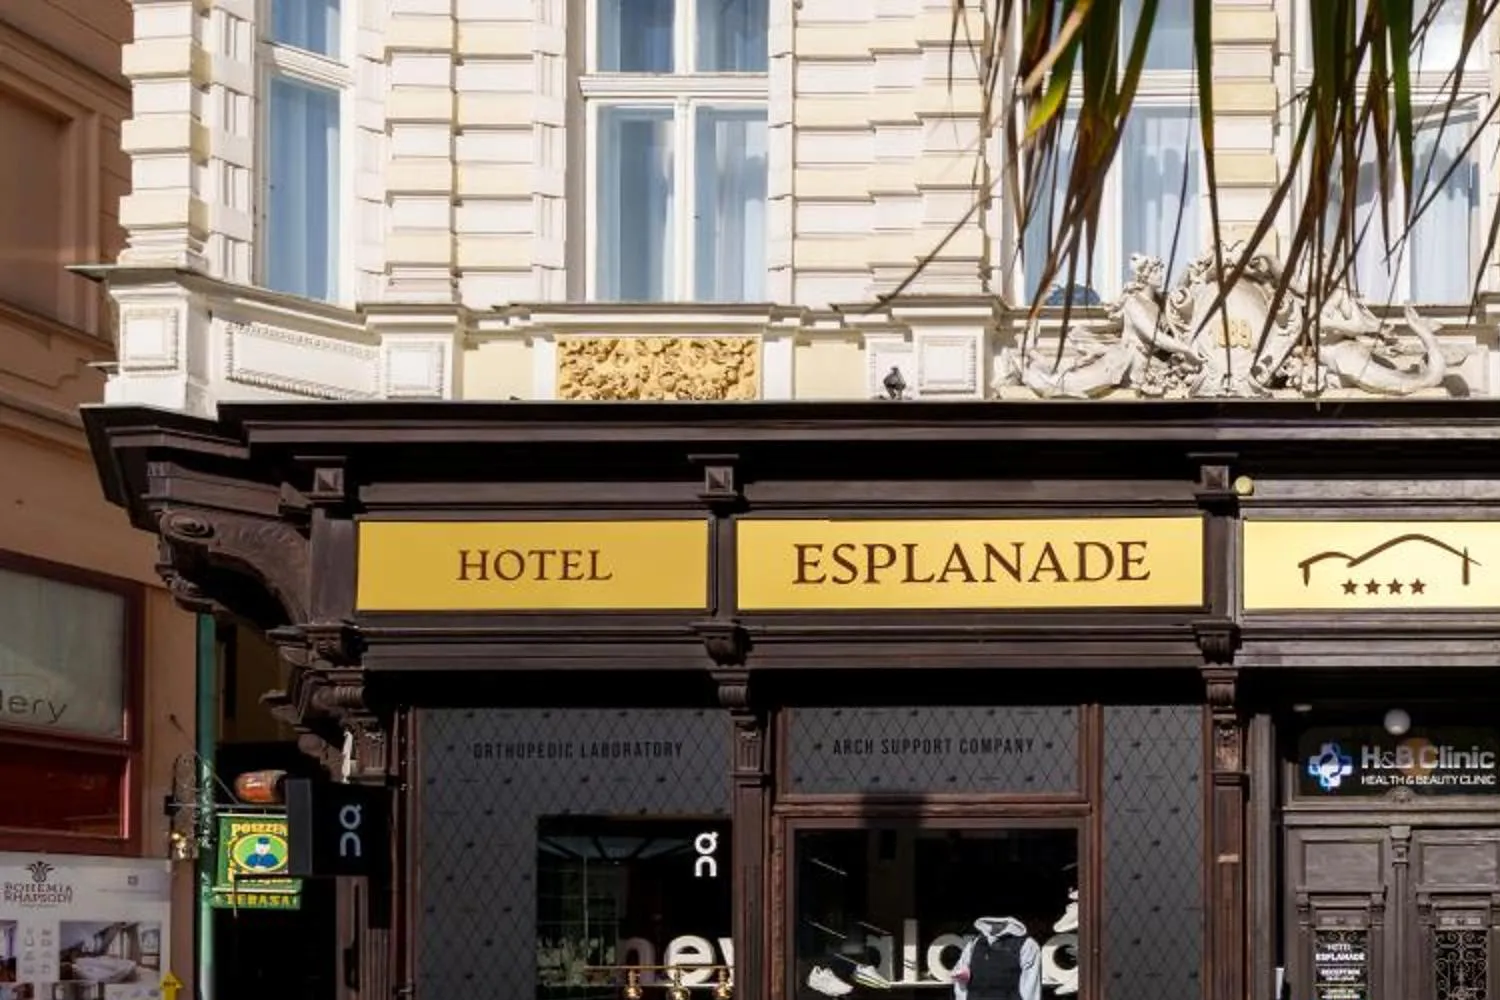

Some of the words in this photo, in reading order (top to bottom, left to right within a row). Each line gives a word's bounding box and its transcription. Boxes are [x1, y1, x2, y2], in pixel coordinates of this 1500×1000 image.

[456, 549, 613, 581] HOTEL
[792, 540, 1151, 584] ESPLANADE
[473, 741, 574, 760] ORTHOPEDIC
[580, 741, 683, 759] LABORATORY
[833, 738, 874, 755] ARCH
[881, 738, 952, 755] SUPPORT
[959, 737, 1034, 754] COMPANY
[1360, 745, 1415, 769] H&B
[1419, 744, 1496, 769] Clinic
[1360, 774, 1405, 785] HEALTH
[1415, 774, 1459, 785] BEAUTY
[1459, 774, 1497, 785] CLINIC
